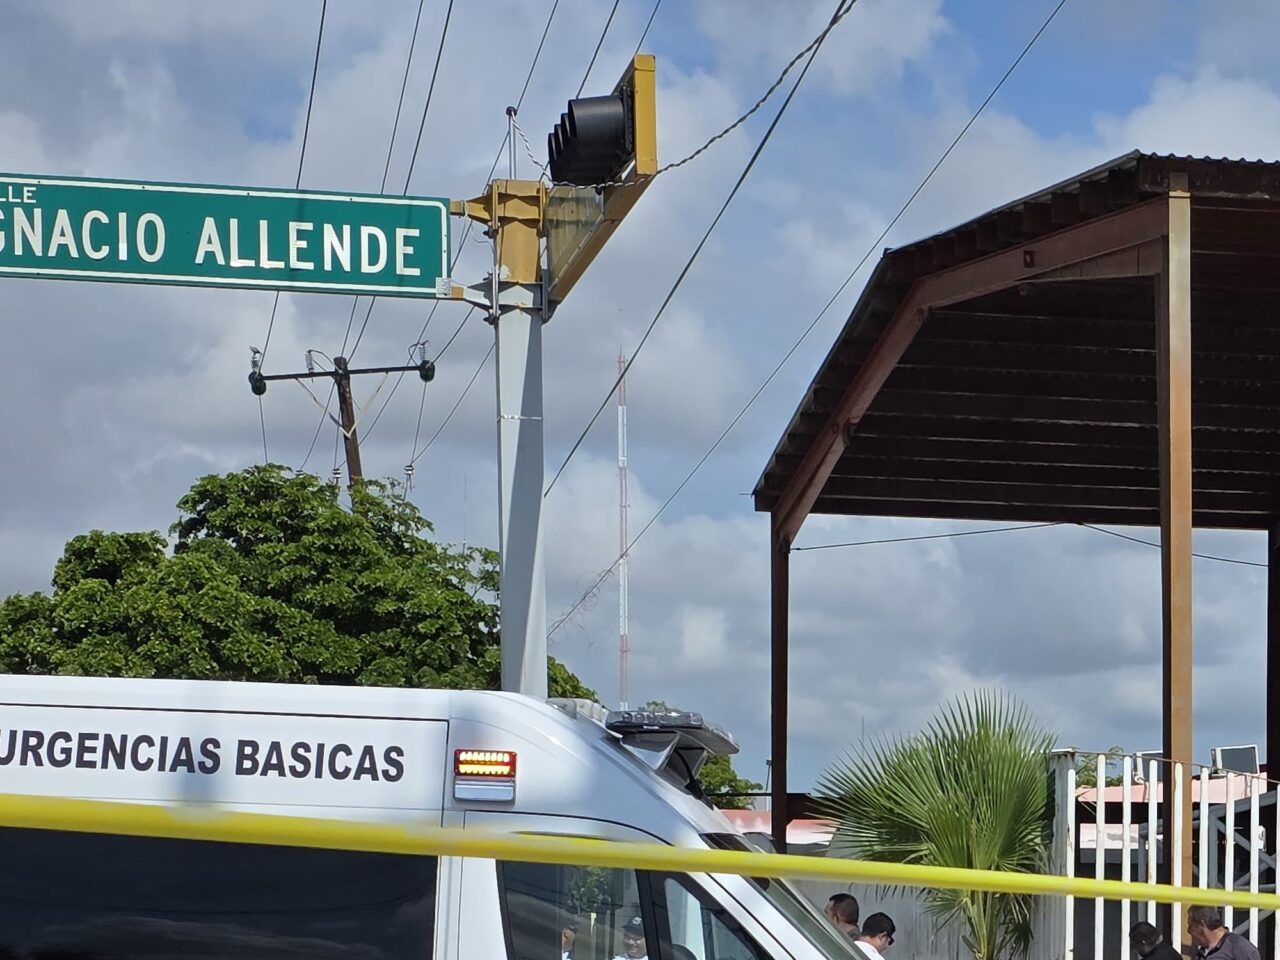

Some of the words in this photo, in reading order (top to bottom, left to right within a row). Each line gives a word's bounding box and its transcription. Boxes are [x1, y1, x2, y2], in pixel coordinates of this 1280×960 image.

[0, 206, 166, 263] NACIO
[195, 216, 421, 276] ALLENDE
[0, 729, 221, 775] URGENCIAS
[235, 739, 405, 782] BASICAS
